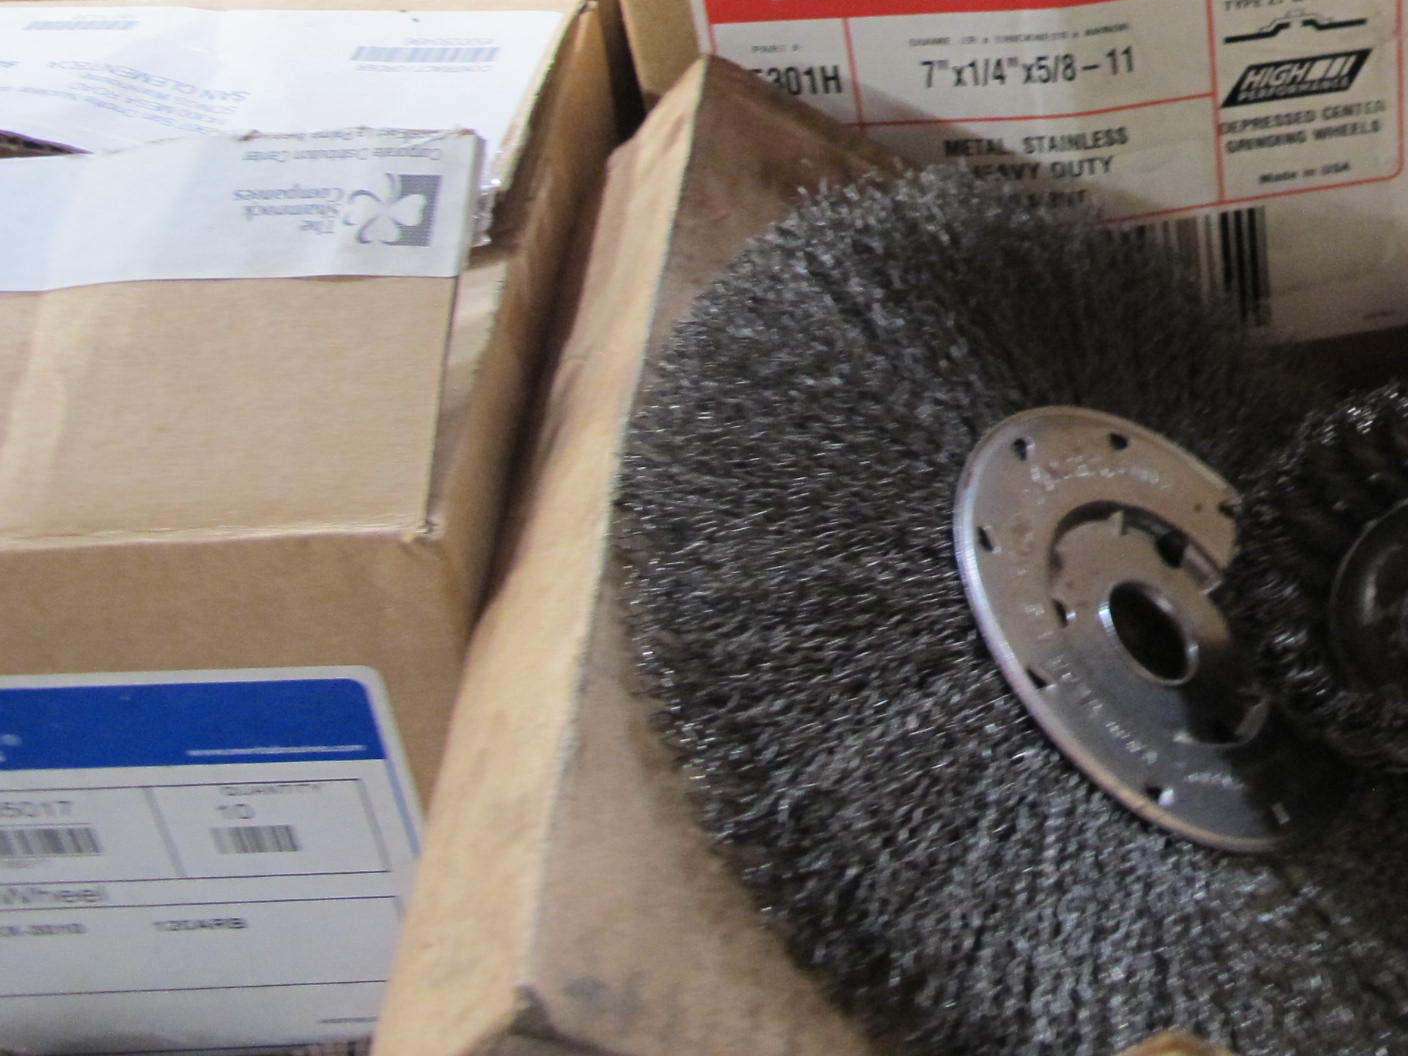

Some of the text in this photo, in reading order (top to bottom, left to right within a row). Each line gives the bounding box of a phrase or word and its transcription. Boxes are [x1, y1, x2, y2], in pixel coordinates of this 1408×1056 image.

[750, 64, 843, 96] 301H
[1240, 61, 1312, 93] HIGH
[1022, 126, 1129, 155] STAINLESS
[1050, 154, 1116, 179] DUTY
[232, 183, 347, 205] Companies
